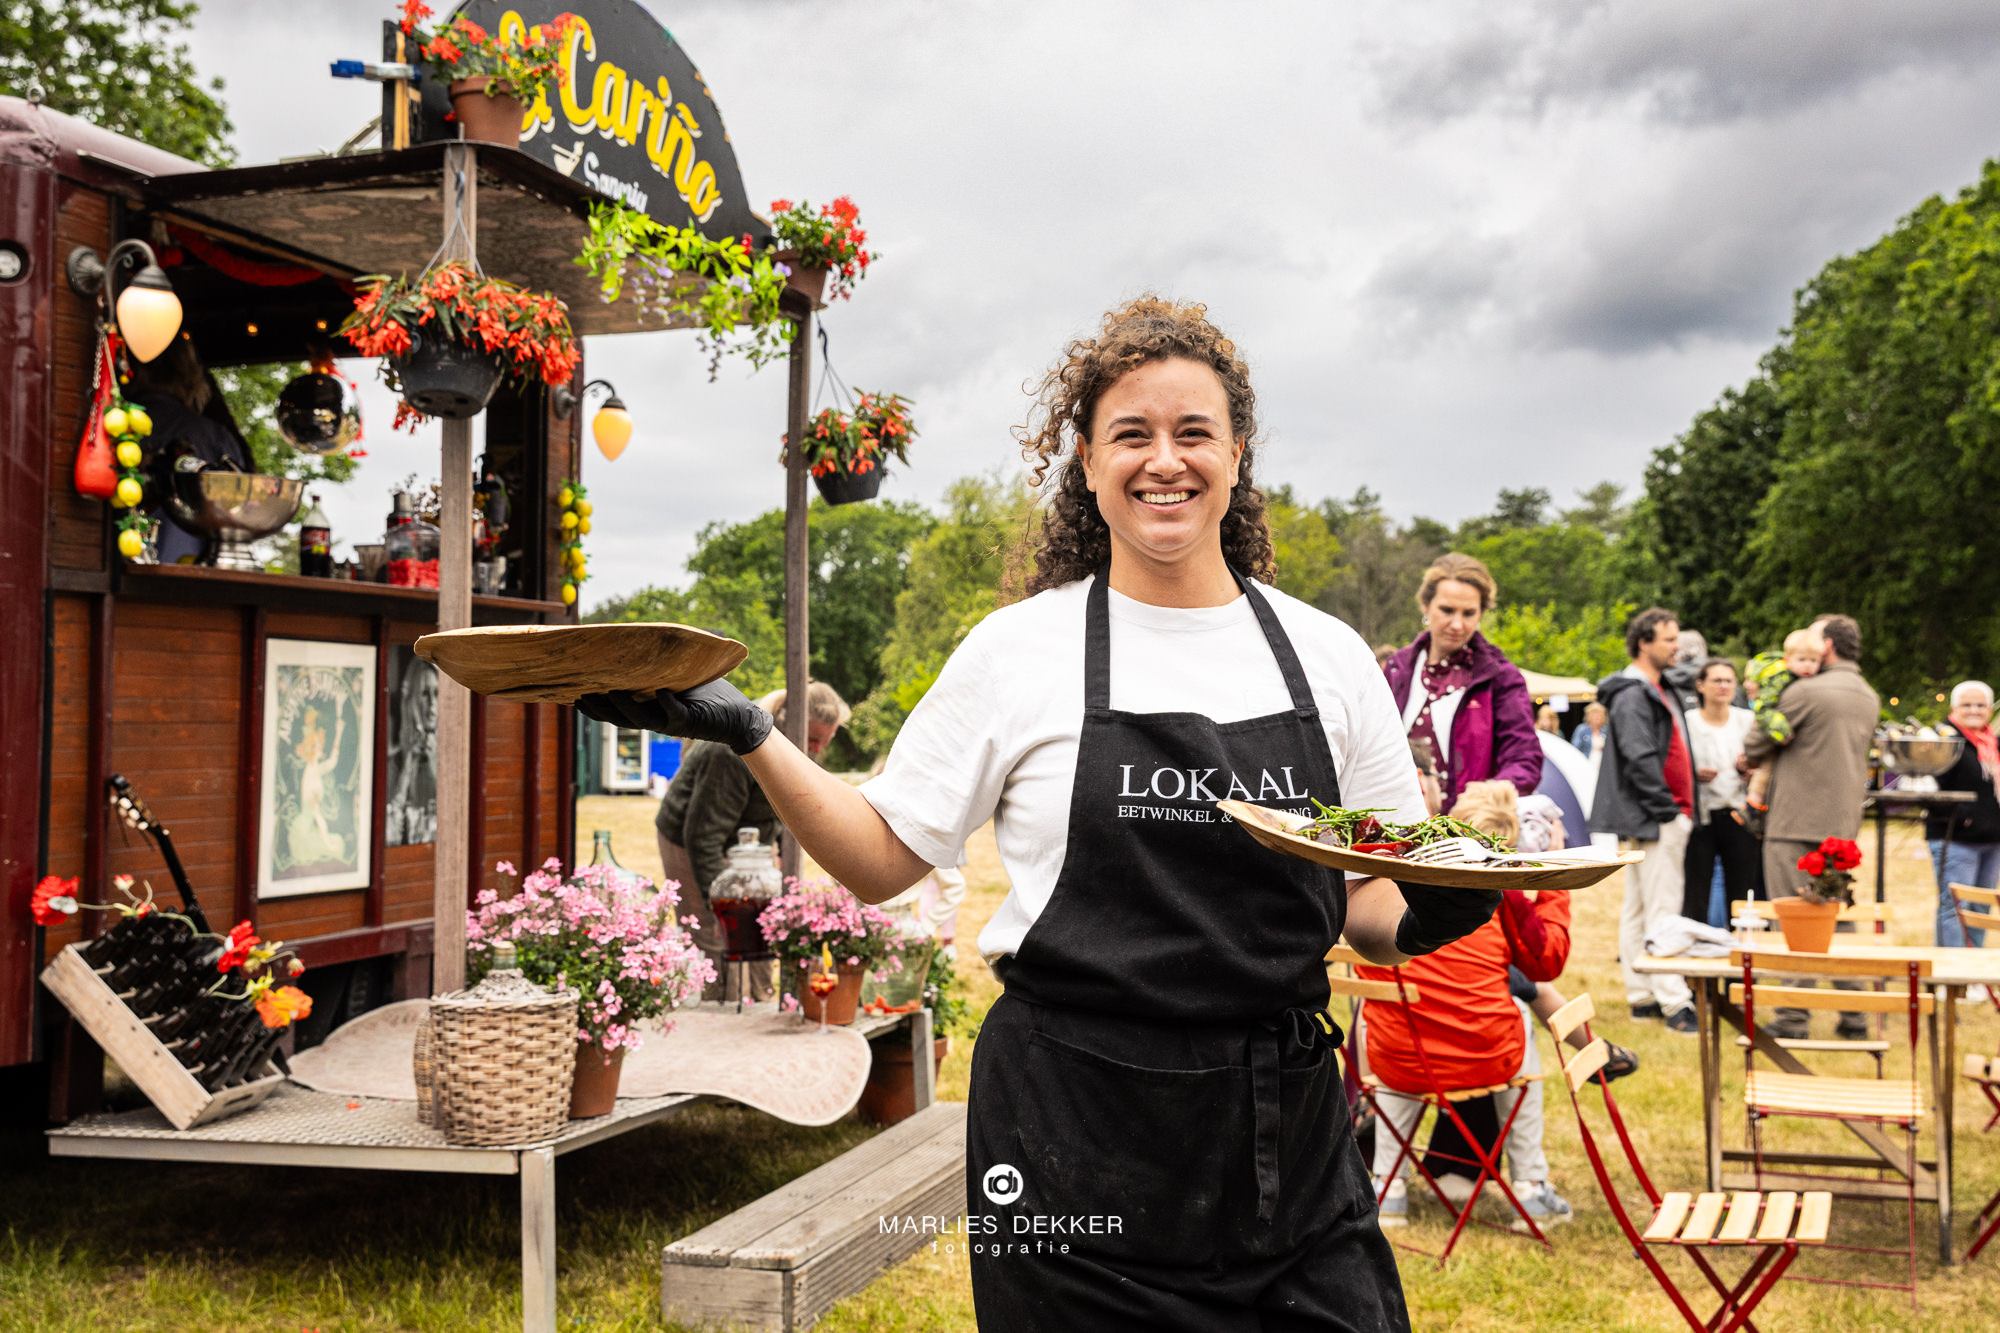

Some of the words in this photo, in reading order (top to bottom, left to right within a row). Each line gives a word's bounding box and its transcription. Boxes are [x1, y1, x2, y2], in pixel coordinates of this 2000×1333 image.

[558, 13, 723, 223] Cariño
[1117, 764, 1309, 803] LOKAAL
[1117, 805, 1216, 824] EETWINKEL
